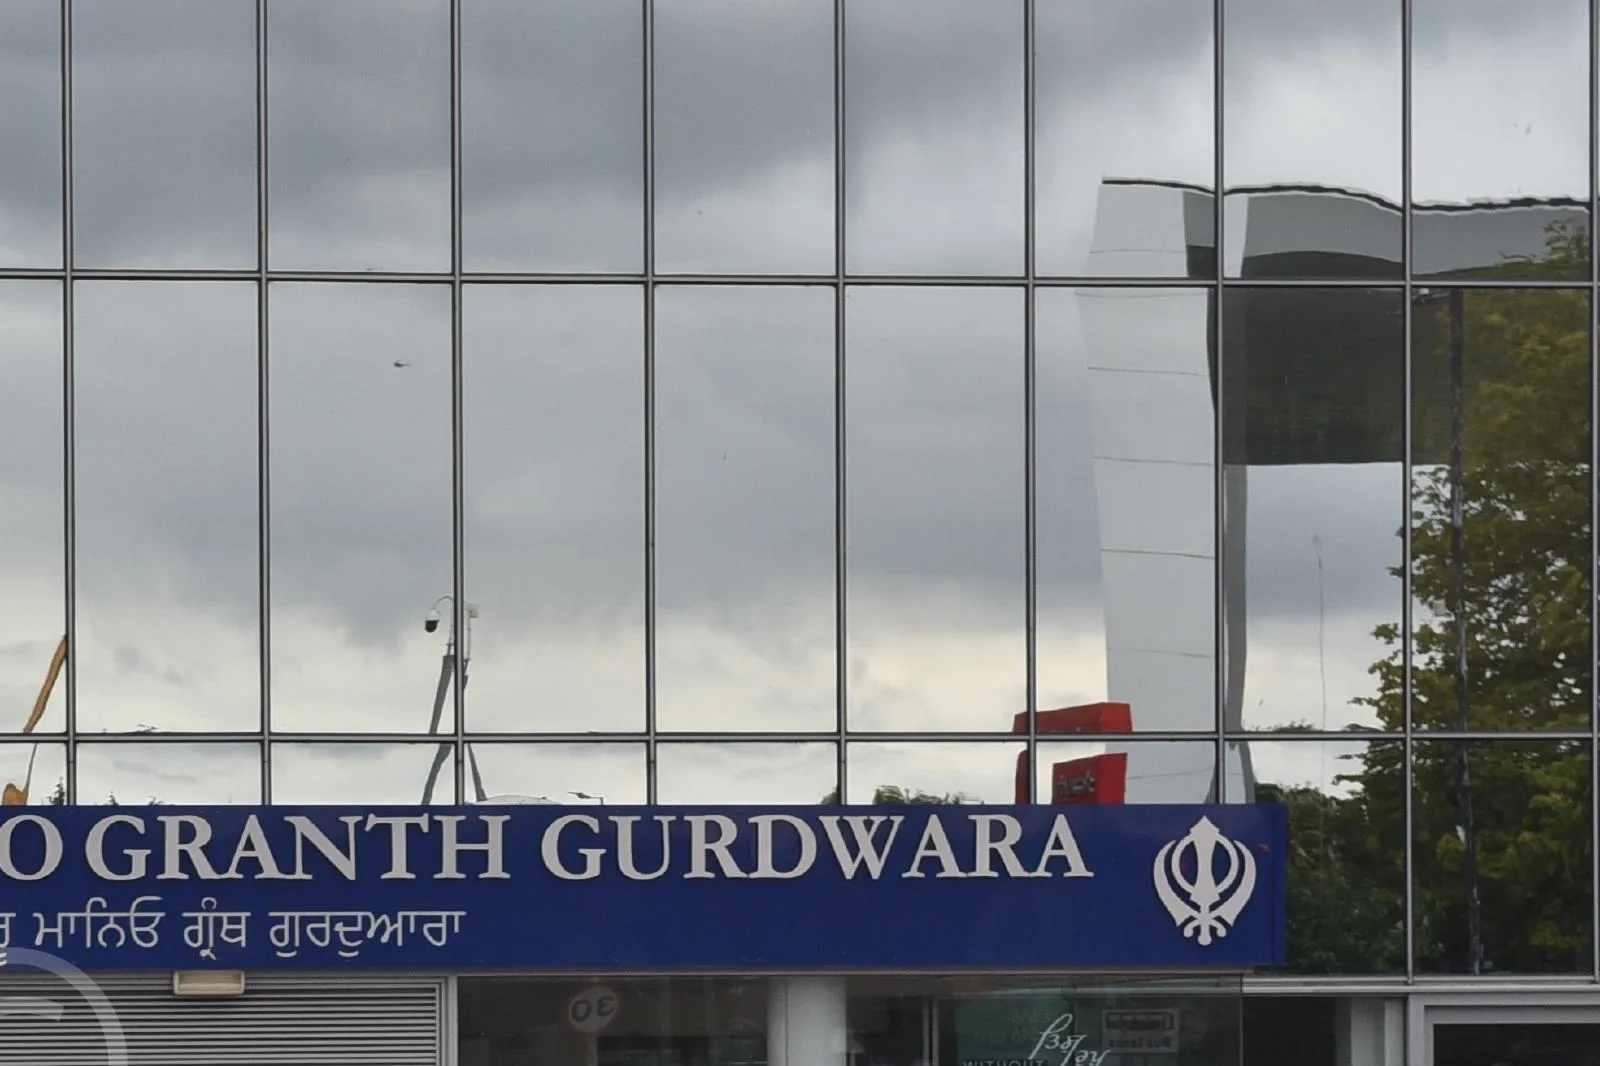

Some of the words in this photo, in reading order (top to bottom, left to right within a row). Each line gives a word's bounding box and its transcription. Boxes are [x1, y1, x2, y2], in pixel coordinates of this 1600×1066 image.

[85, 812, 511, 881] GRANTH
[541, 813, 1095, 880] GURDWARA
[32, 895, 166, 948] ਮਾਨਿਓ
[181, 896, 252, 961] ਗ੍ਰੰਥ
[268, 910, 467, 958] ਗੁਰਦੁਆਰਾ
